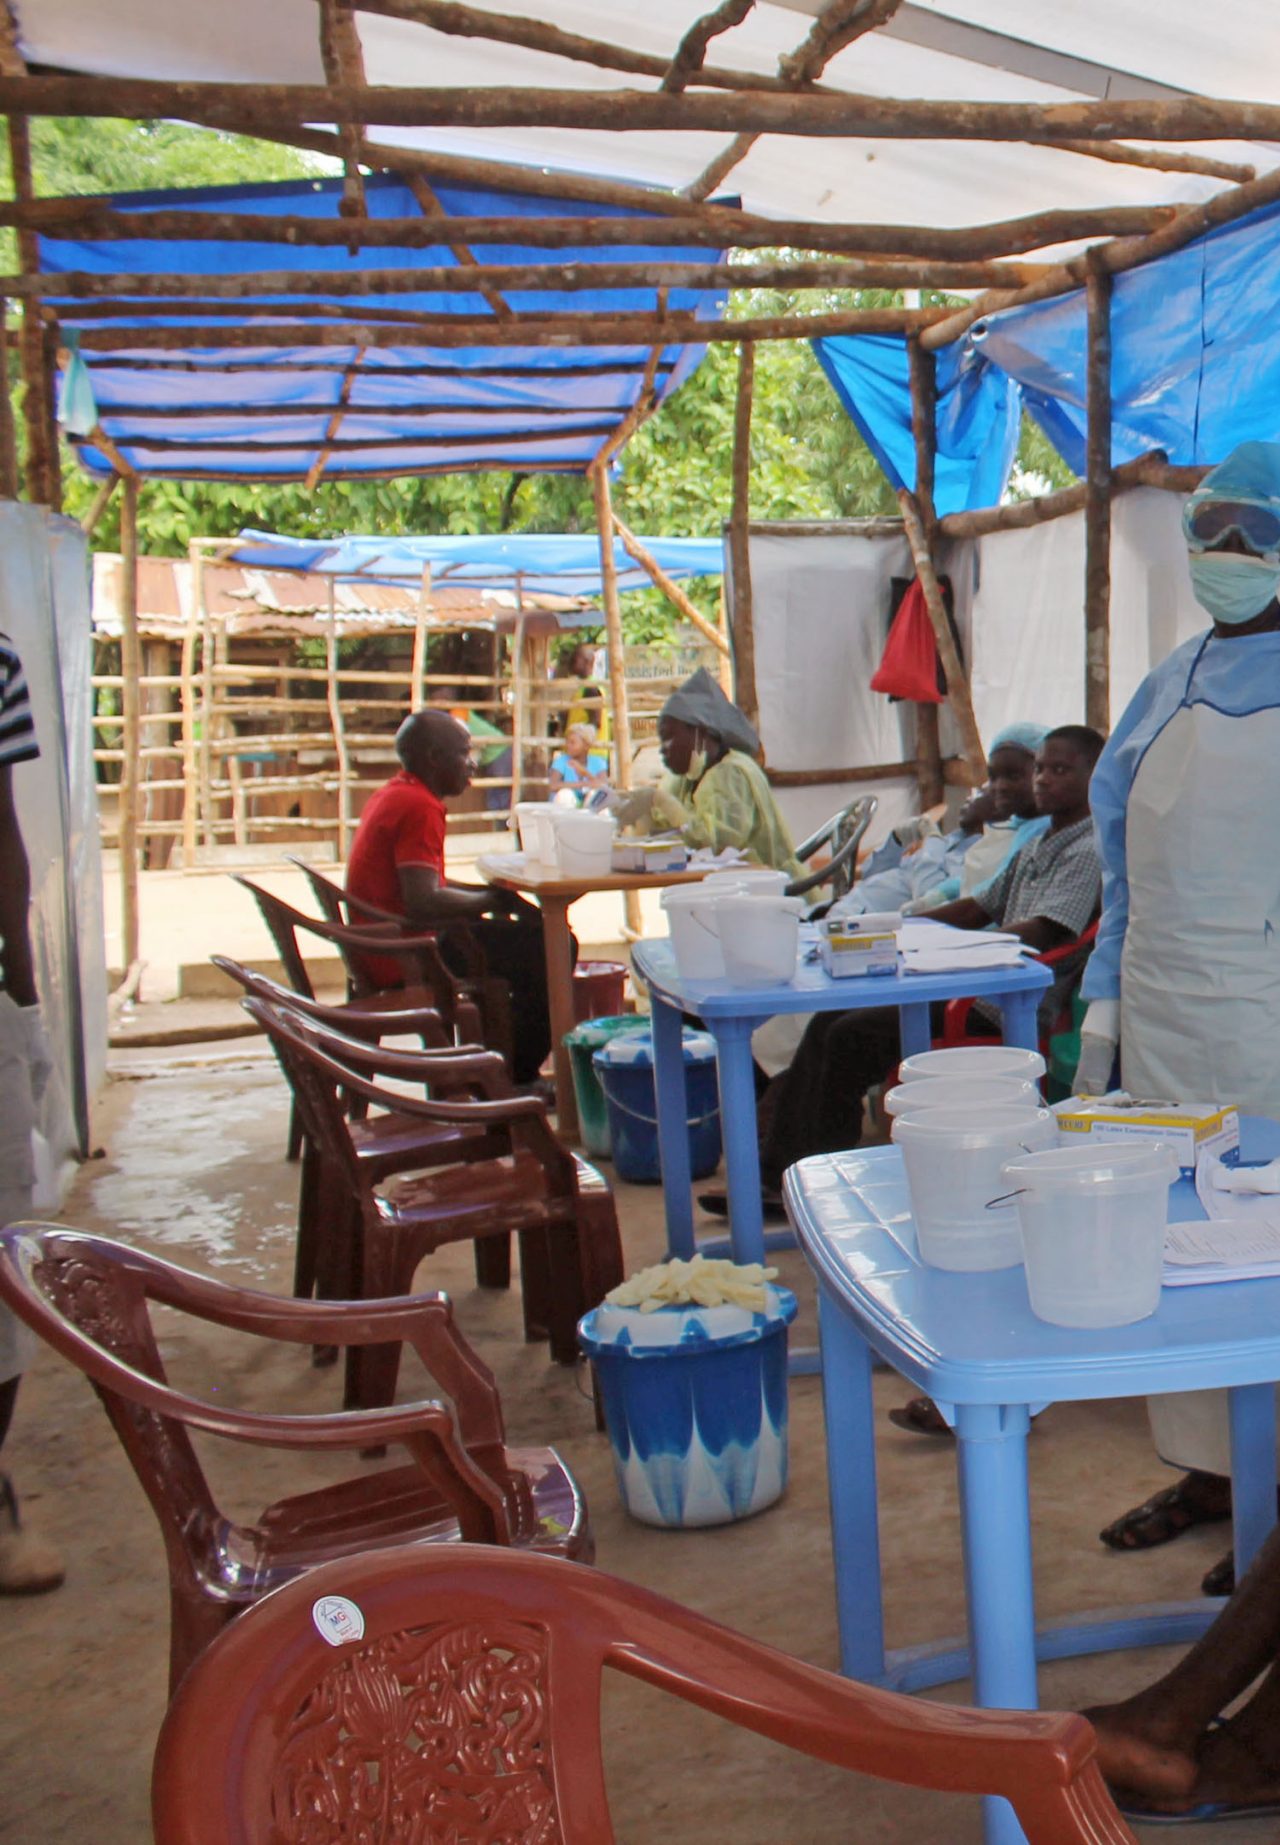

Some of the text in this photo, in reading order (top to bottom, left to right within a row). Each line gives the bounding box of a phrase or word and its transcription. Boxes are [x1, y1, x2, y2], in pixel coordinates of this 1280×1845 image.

[625, 664, 673, 678] ssisted
[1106, 1126, 1124, 1134] Latex
[1125, 1127, 1165, 1138] Examination
[1166, 1129, 1189, 1138] Gloves
